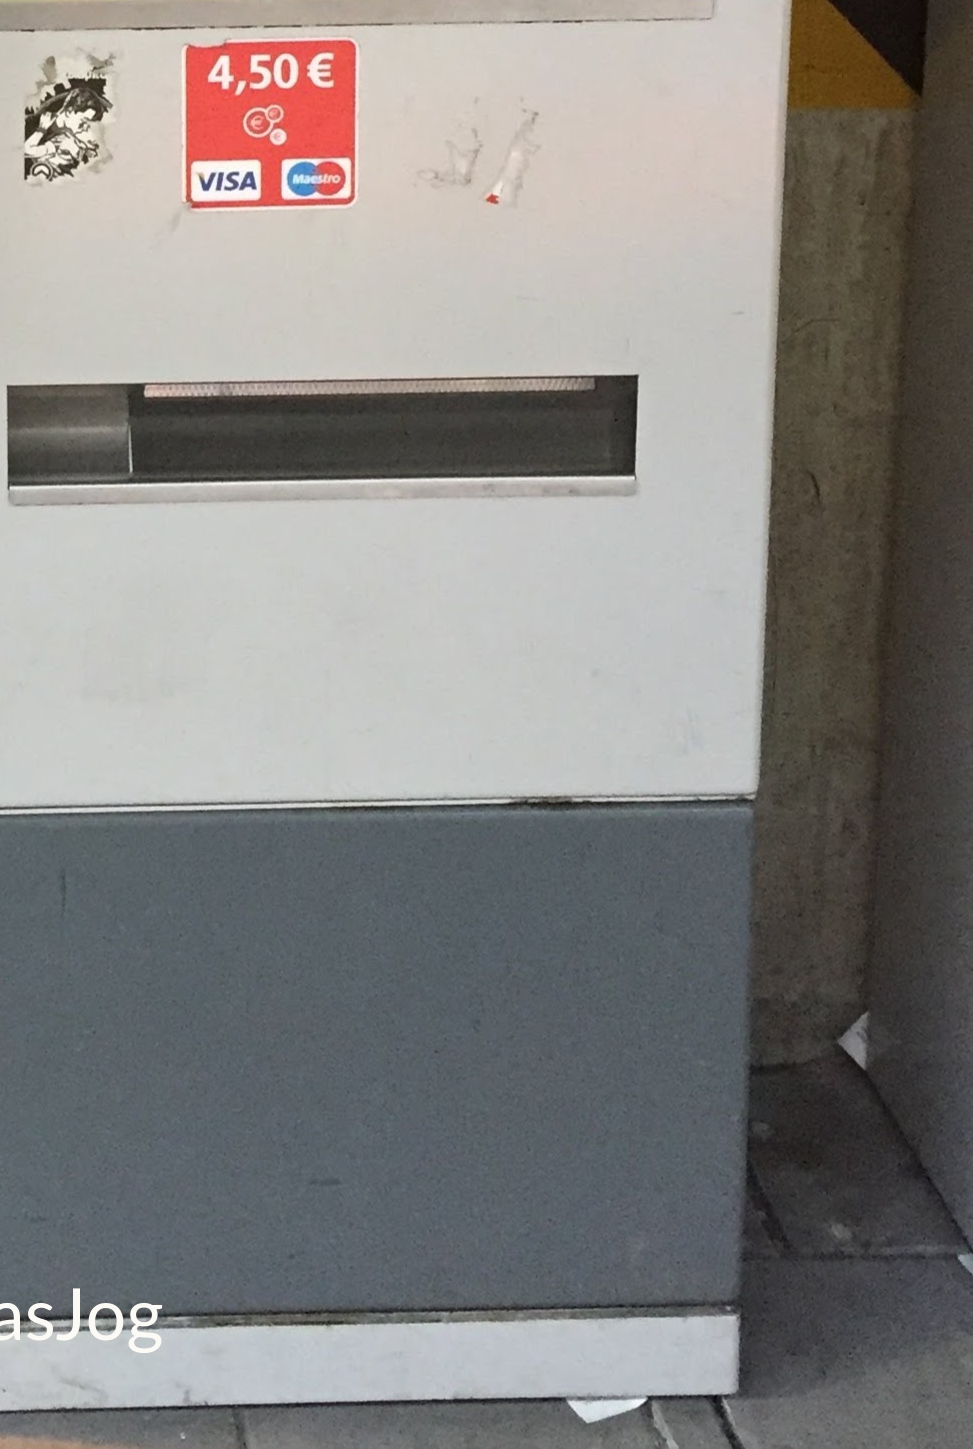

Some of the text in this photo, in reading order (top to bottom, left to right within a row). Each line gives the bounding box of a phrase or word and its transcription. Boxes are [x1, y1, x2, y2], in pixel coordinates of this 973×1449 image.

[207, 53, 335, 96] 4,50 €
[198, 171, 257, 192] VISA
[293, 172, 341, 186] Maestro
